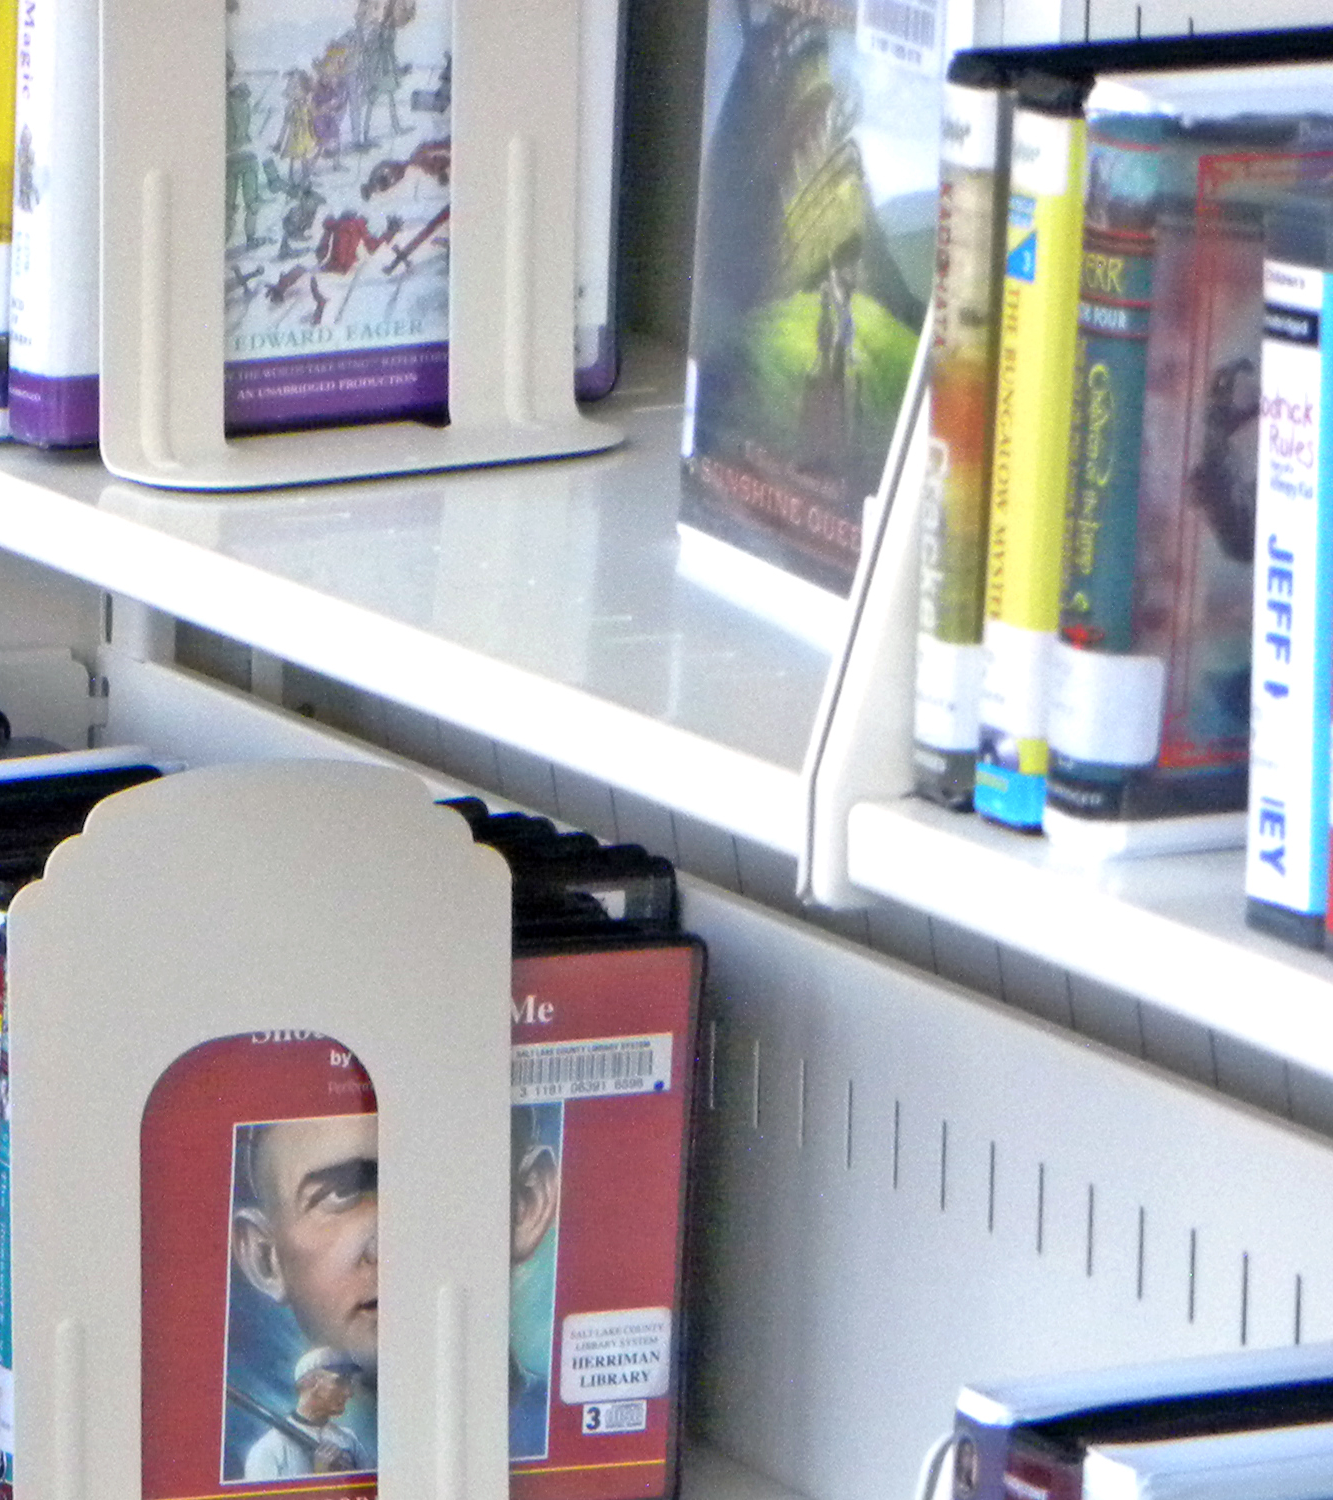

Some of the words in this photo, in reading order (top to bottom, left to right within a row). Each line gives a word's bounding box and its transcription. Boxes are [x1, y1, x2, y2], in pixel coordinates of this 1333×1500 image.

[20, 0, 36, 100] Magic
[234, 326, 333, 352] EDWARD
[345, 319, 423, 343] EAGER
[258, 378, 336, 398] UNABRIDGED
[338, 372, 419, 391] PRODUCTION
[994, 348, 1020, 515] BUNGALOW
[1264, 533, 1295, 665] JEFF
[329, 1049, 352, 1068] by
[596, 1326, 621, 1338] LAKE
[623, 1322, 665, 1335] COUNTY
[575, 1339, 616, 1352] LIBRARY
[620, 1336, 659, 1348] SYSTEM
[572, 1350, 661, 1370] HERRIMAN
[579, 1369, 651, 1389] LIBRARY
[585, 1405, 601, 1430] 3
